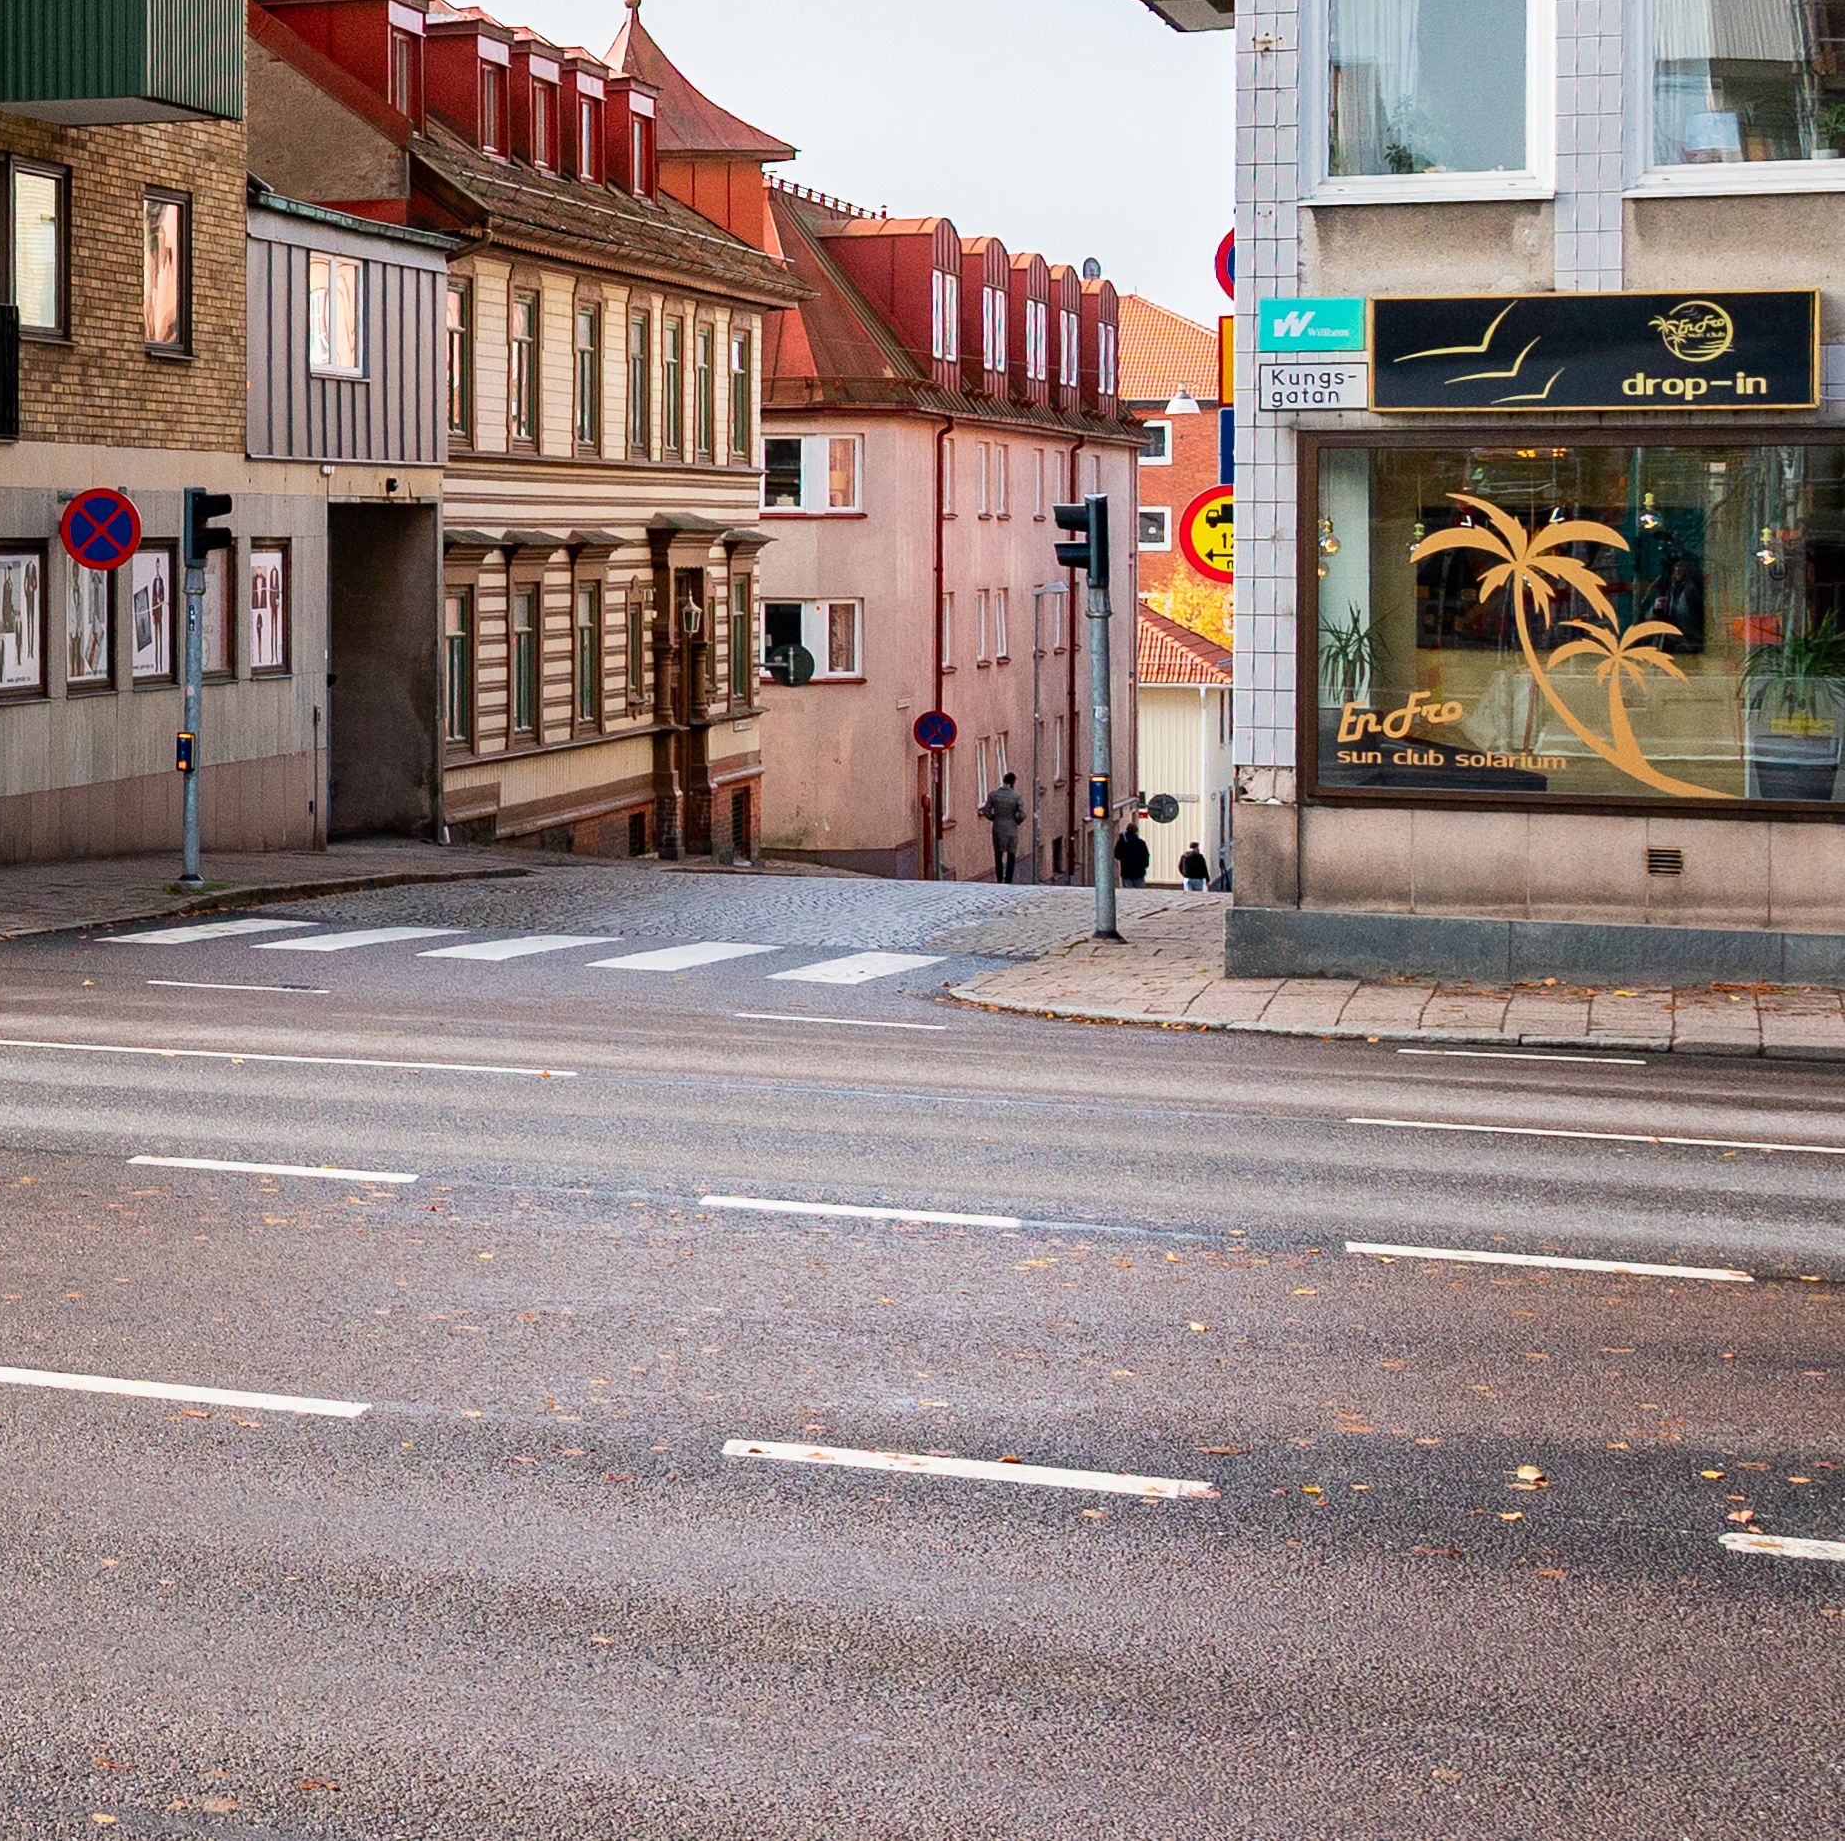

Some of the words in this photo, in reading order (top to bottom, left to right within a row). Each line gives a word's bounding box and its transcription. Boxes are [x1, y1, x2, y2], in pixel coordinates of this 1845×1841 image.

[1271, 369, 1357, 389] Kungs-
[1621, 371, 1768, 401] drop-in
[1271, 388, 1341, 408] gatan
[1337, 750, 1382, 764] sun
[1392, 749, 1445, 767] club
[1455, 751, 1567, 770] solarium
